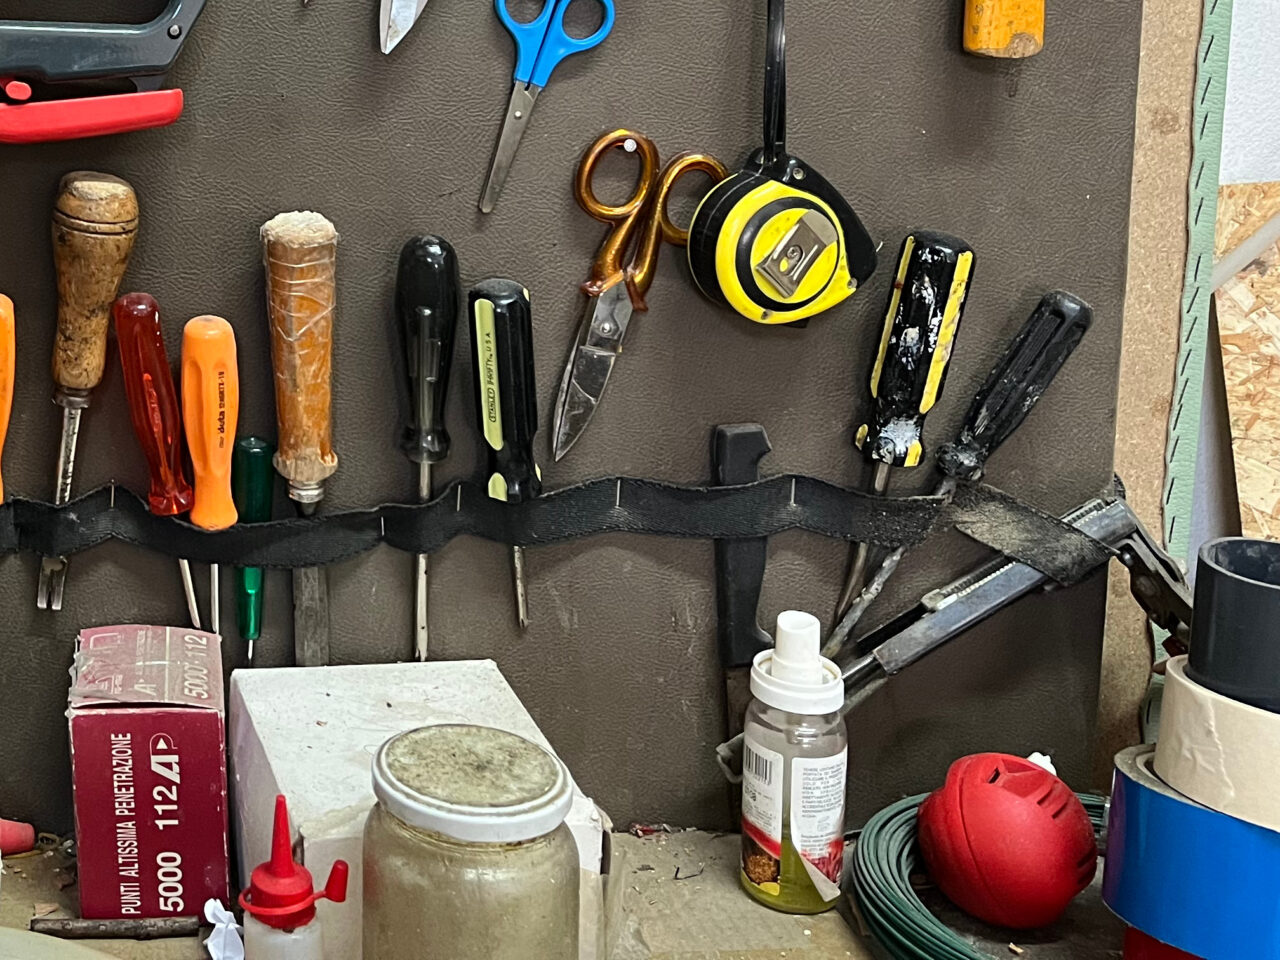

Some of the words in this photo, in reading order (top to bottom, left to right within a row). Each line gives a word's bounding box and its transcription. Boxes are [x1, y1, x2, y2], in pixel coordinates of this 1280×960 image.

[184, 635, 208, 656] 112
[184, 666, 208, 698] 5000
[111, 733, 135, 815] PENETRAZIONE
[153, 785, 179, 830] 112
[116, 821, 139, 877] ALTISSIMA
[120, 883, 142, 914] PUNTI
[156, 851, 184, 912] 5000
